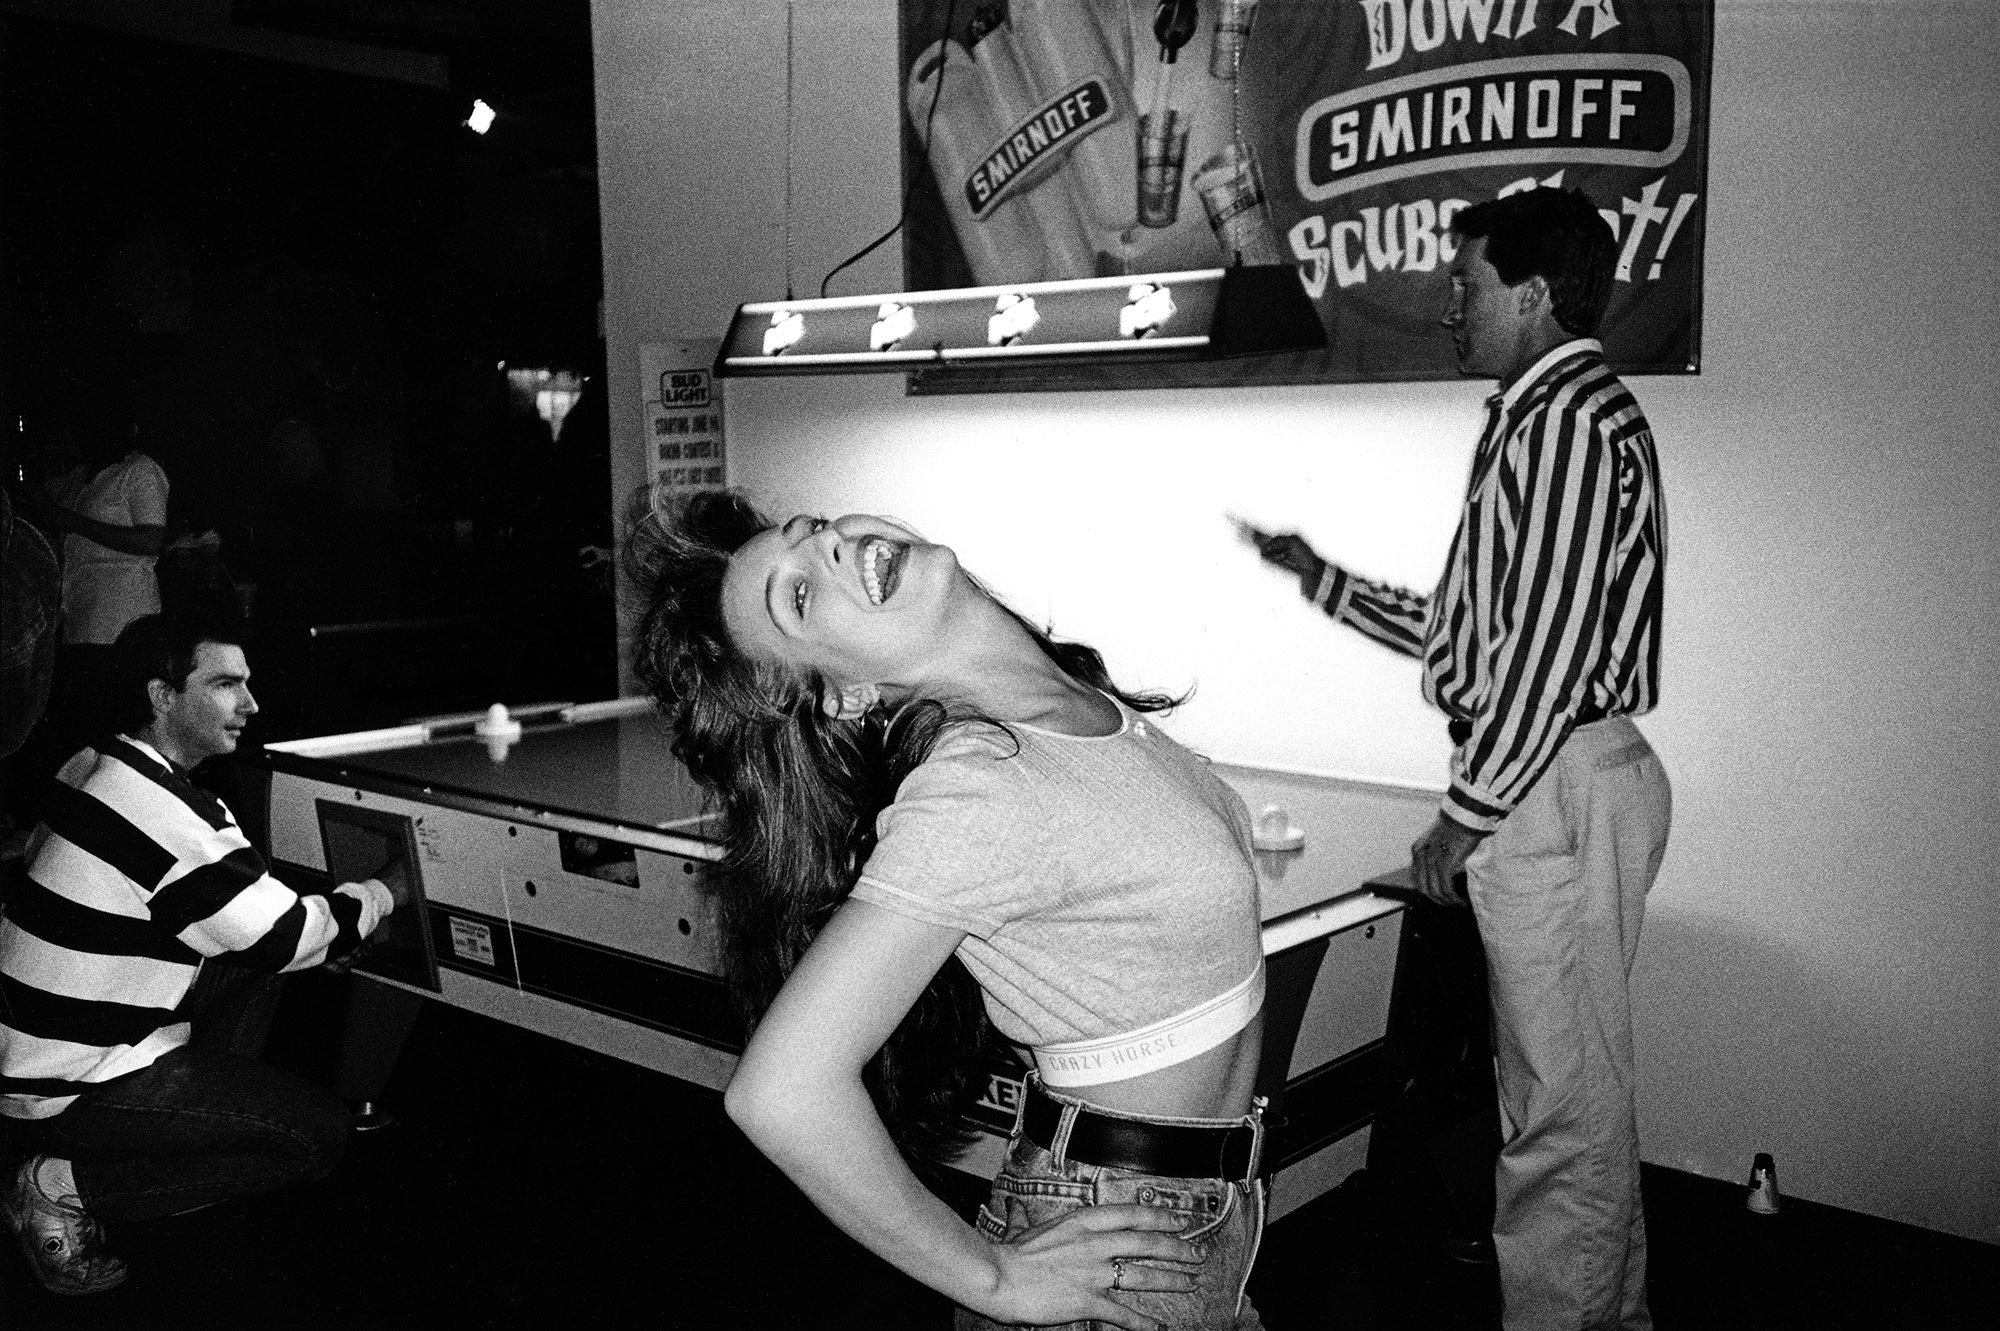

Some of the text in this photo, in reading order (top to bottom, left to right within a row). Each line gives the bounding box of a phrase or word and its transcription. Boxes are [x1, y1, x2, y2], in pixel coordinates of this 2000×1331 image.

[971, 89, 1092, 202] SMIRNOFF
[1330, 79, 1643, 172] SMIRNOFF
[665, 388, 707, 403] LIGHT
[671, 374, 702, 388] BUD
[1049, 1032, 1178, 1072] CRAZY HORSE
